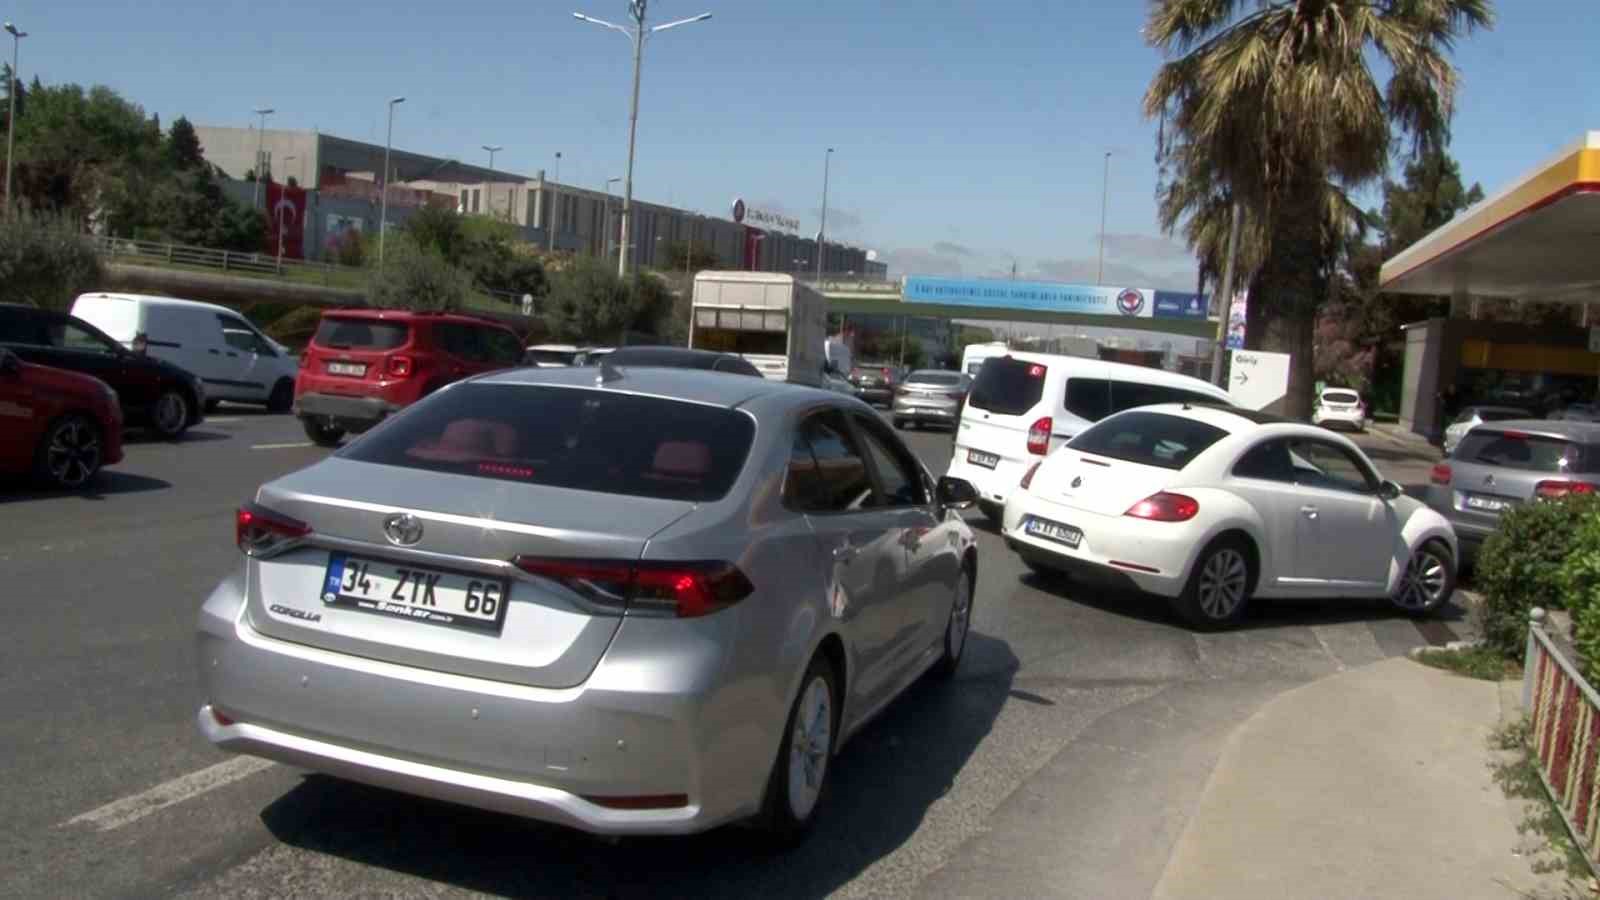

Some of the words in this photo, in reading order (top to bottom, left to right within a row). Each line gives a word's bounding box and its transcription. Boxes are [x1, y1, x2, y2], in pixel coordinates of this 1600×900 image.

[342, 561, 371, 595] 34
[391, 569, 441, 606] ZTK
[465, 580, 498, 615] 66
[270, 604, 321, 623] COROLLA
